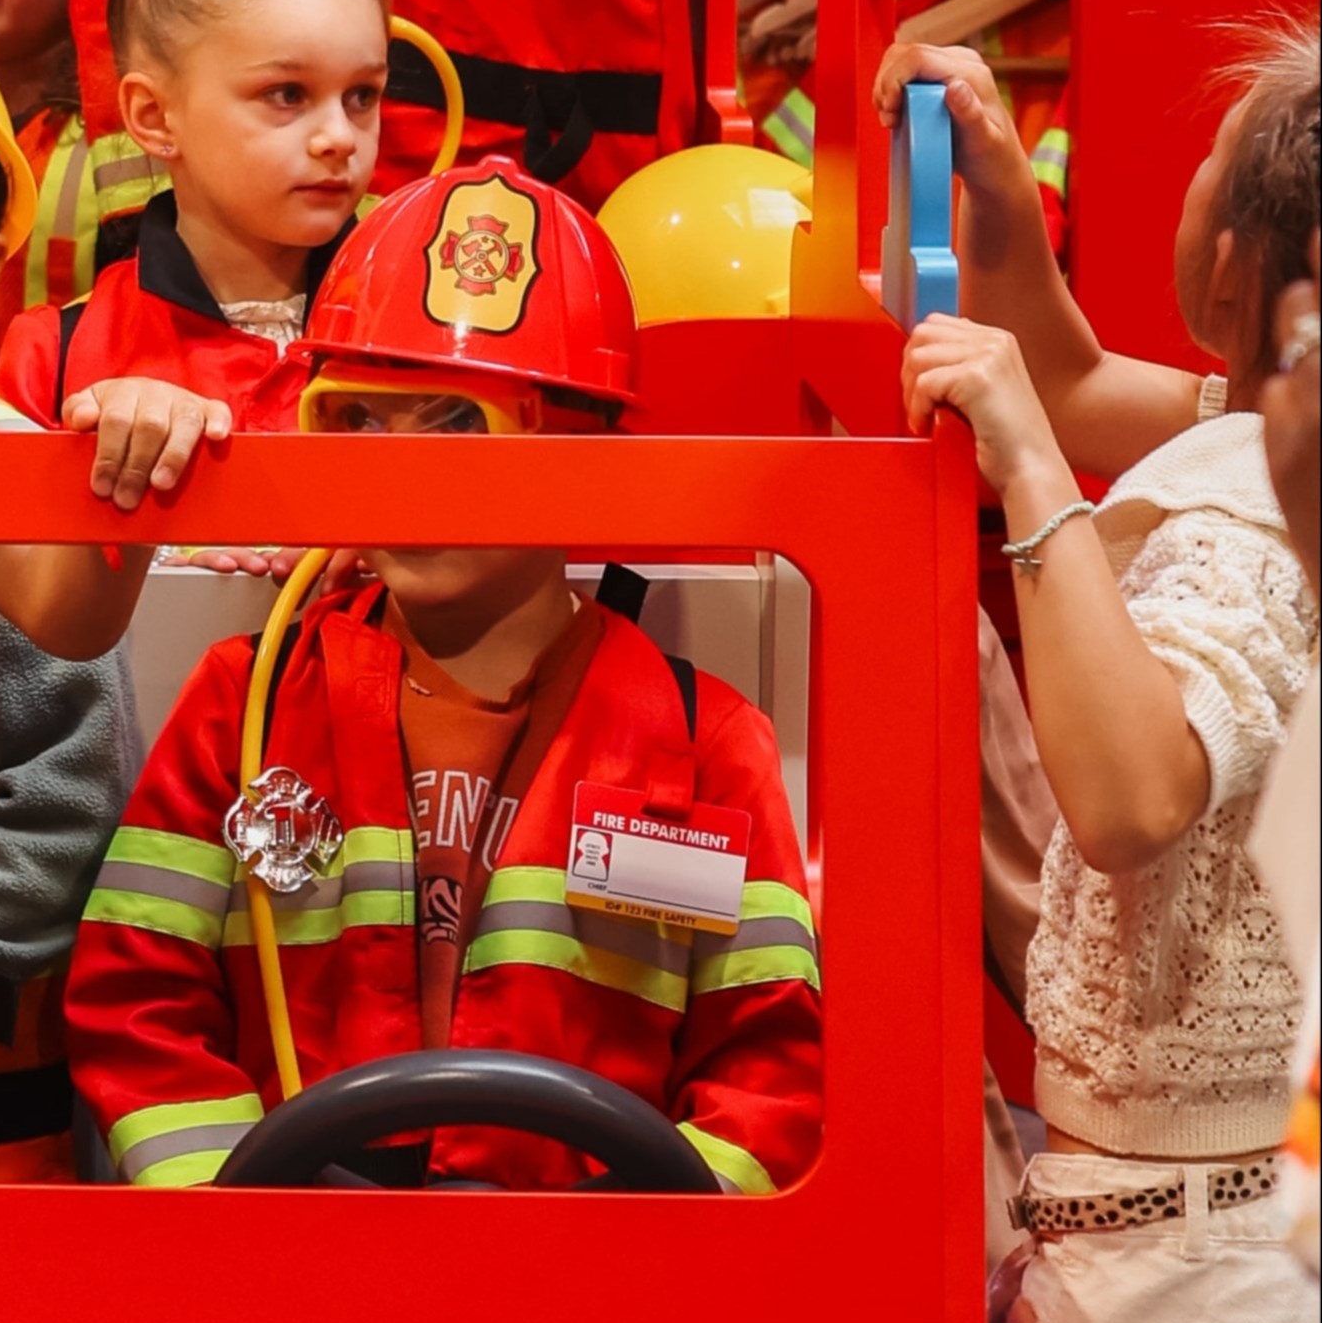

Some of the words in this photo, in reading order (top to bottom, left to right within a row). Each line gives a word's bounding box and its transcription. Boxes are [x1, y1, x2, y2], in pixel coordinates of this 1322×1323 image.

[593, 811, 626, 830] FIRE
[629, 818, 731, 850] DEPARTMENT
[587, 883, 608, 891] CHIEF
[605, 901, 621, 911] ID#
[625, 905, 641, 915] 123
[643, 907, 662, 920] FIRE
[664, 910, 696, 926] SAFETY
